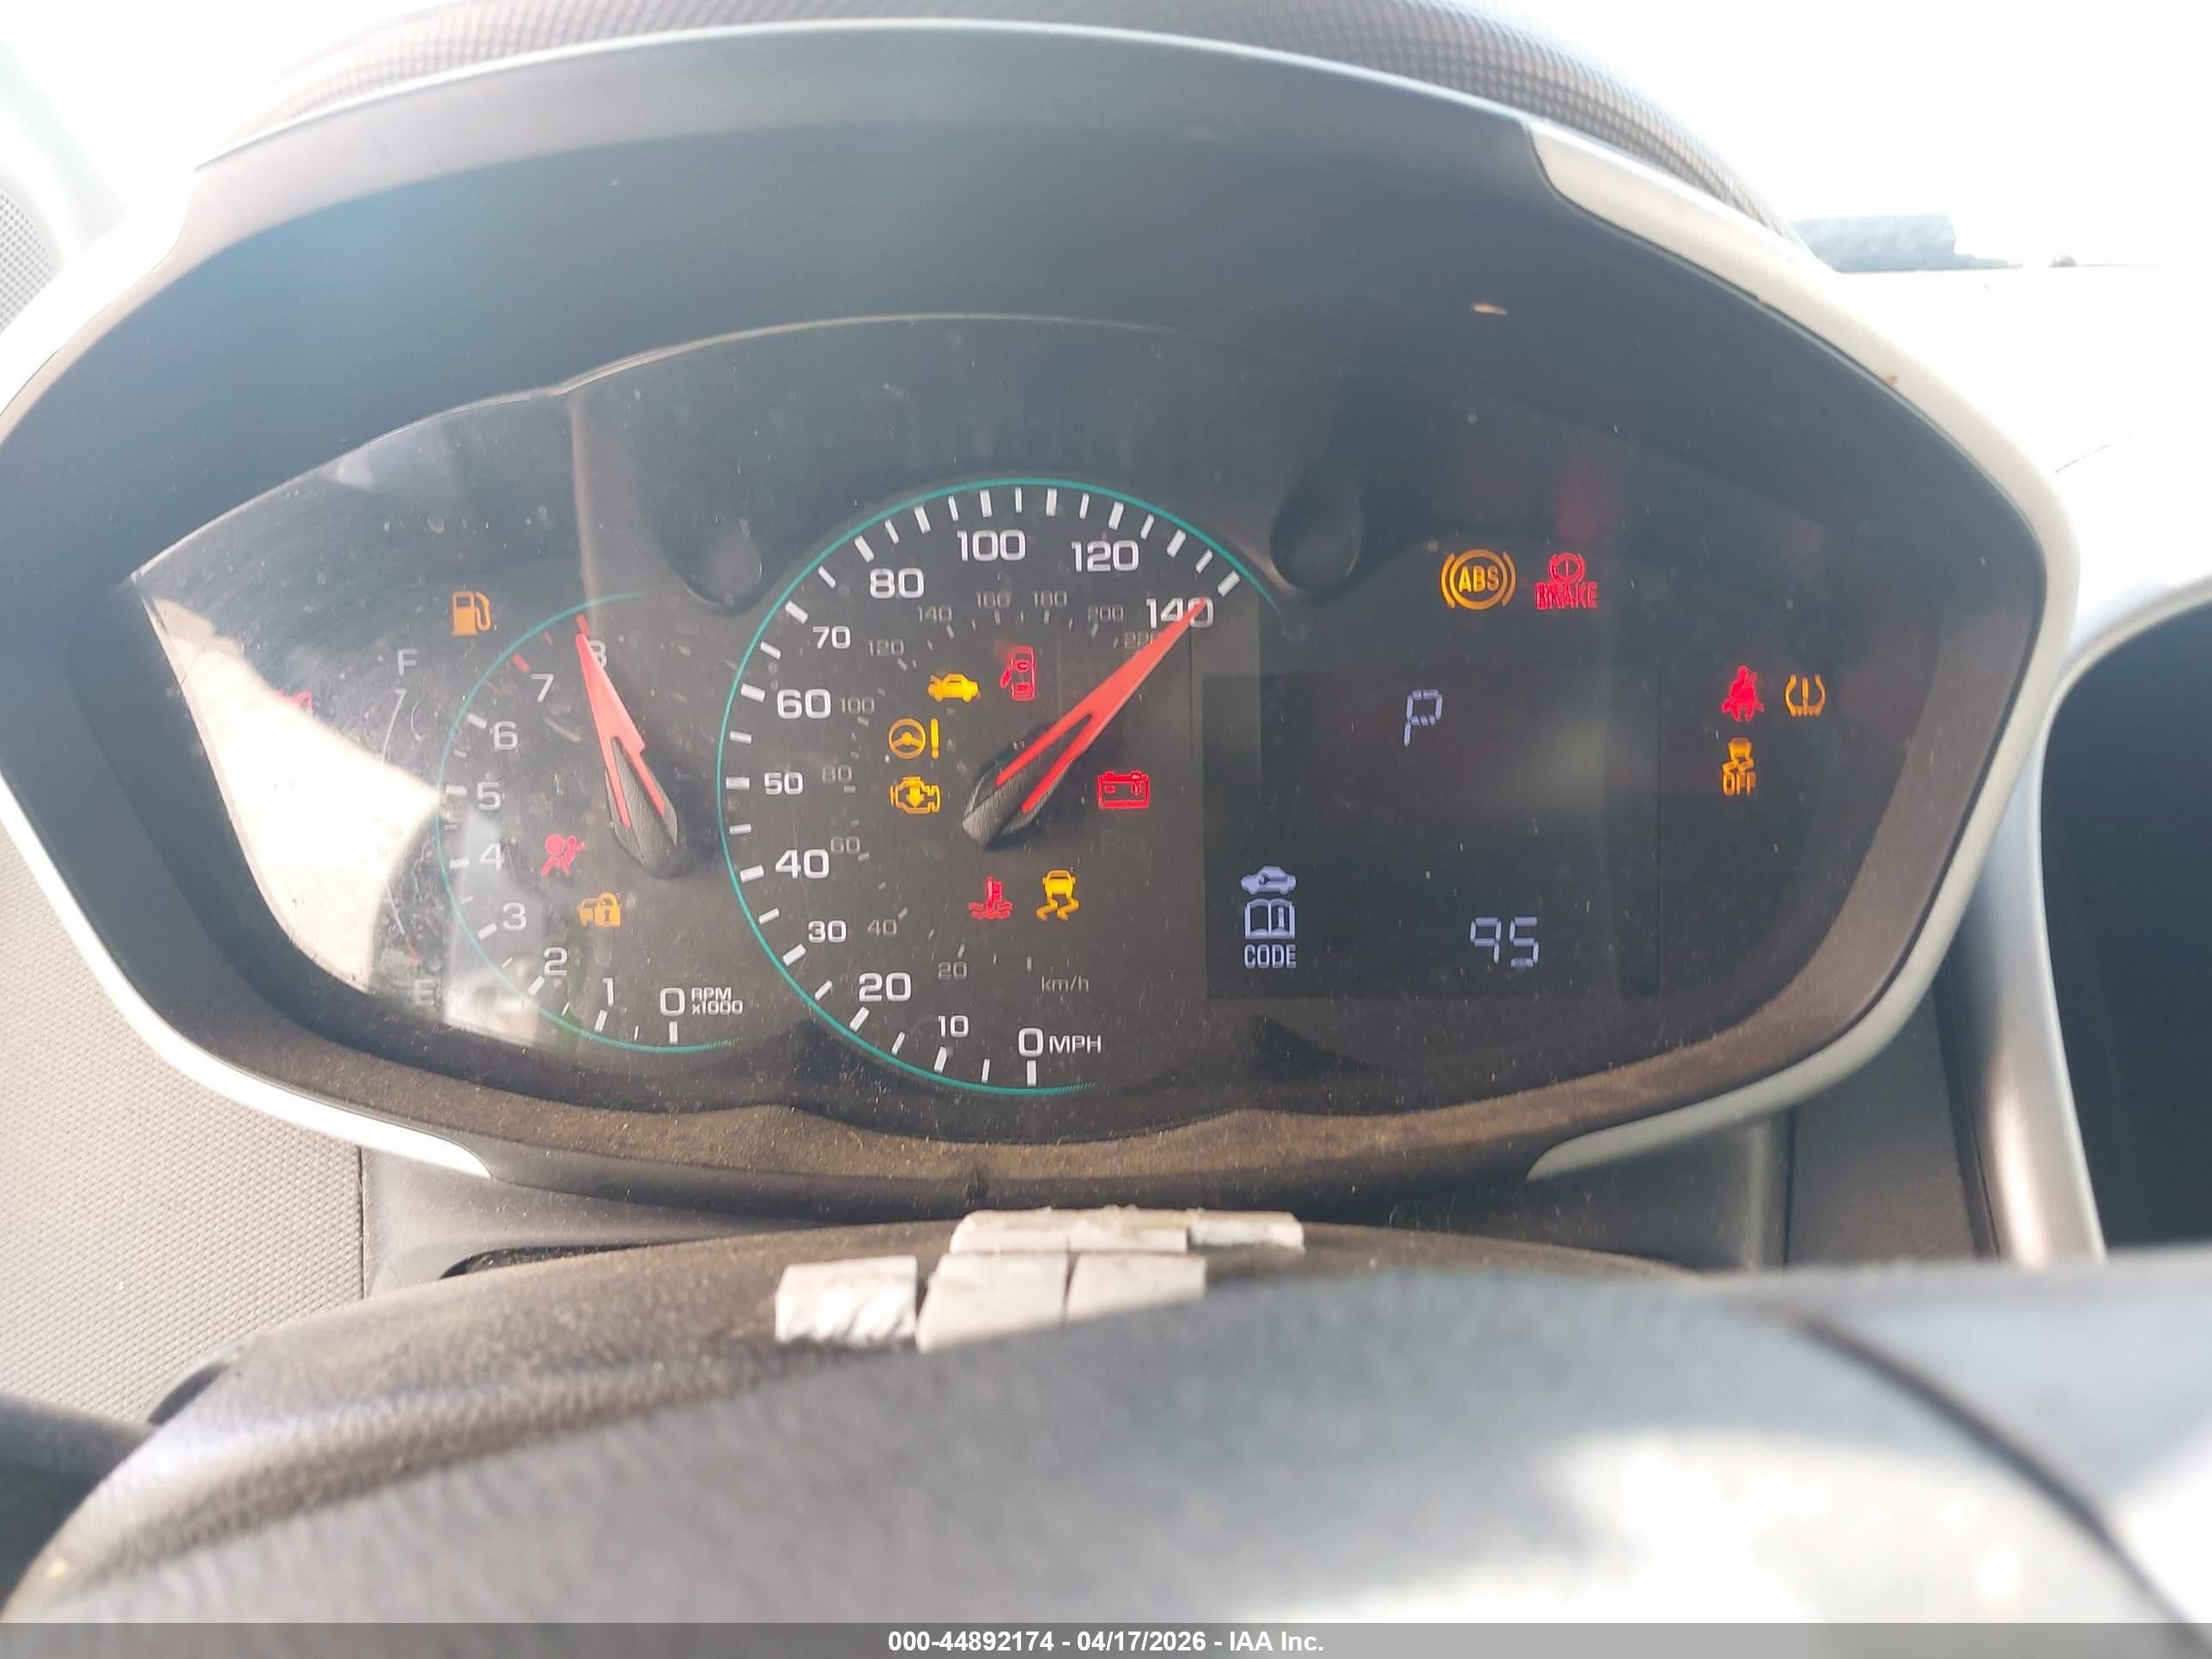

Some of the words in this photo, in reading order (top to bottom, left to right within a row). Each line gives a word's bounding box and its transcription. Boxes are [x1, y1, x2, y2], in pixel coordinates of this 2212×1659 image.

[957, 530, 1026, 562] 100
[1072, 541, 1139, 572] 120
[869, 568, 925, 599] 80
[1458, 564, 1500, 592] ABS
[1535, 580, 1598, 610] BRAKE
[918, 605, 952, 623] 140
[1146, 598, 1214, 629] 140
[812, 625, 852, 650] 70
[867, 639, 904, 657] 120
[398, 649, 417, 676] F
[531, 673, 554, 702] 7
[776, 689, 832, 720] 60
[840, 696, 875, 714] 100
[1403, 690, 1443, 747] P
[493, 720, 519, 751] 6
[477, 781, 501, 811] 5
[763, 772, 804, 795] 50
[1722, 771, 1756, 796] OFF
[479, 842, 505, 871] 4
[830, 836, 860, 855] 60
[775, 848, 830, 879] 40
[502, 902, 528, 931] 3
[866, 920, 898, 937] 40
[807, 921, 847, 943] 30
[1469, 916, 1540, 969] 95
[544, 947, 568, 976] 2
[938, 961, 969, 981] 20
[1243, 943, 1297, 970] CODE
[602, 978, 614, 1006] 1
[859, 972, 913, 1002] 20
[1040, 975, 1091, 993] km/h
[659, 987, 685, 1017] 0
[690, 986, 732, 1001] RPM
[691, 1000, 744, 1015] x1000
[938, 1015, 969, 1037] 10
[1018, 1027, 1044, 1057] 0
[1048, 1034, 1103, 1054] MPH
